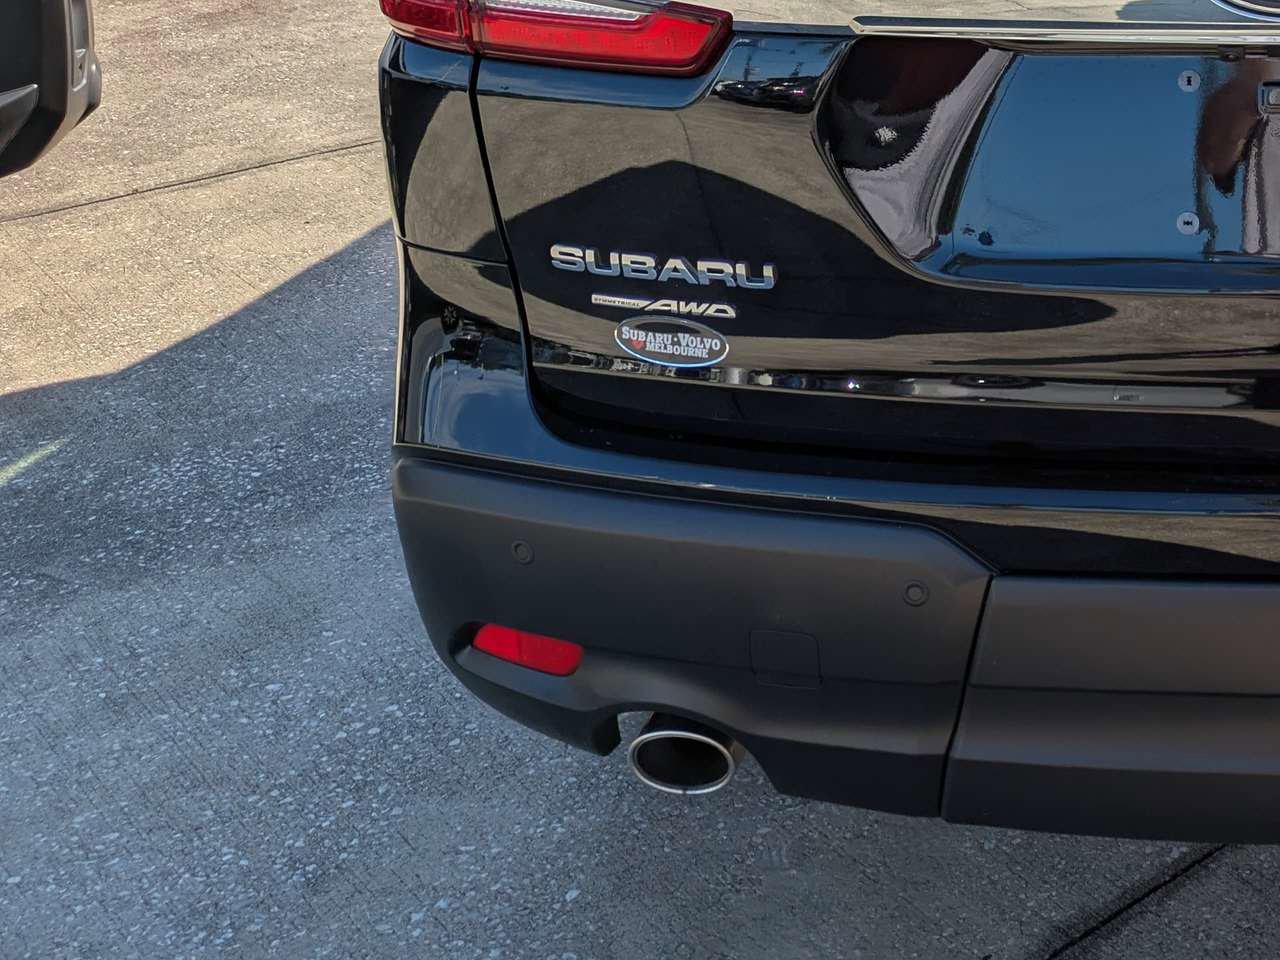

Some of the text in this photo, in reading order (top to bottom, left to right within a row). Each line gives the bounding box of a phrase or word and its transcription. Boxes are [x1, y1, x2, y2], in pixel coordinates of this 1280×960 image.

[550, 244, 776, 290] SUBARU
[594, 297, 736, 319] SYMMETRICAL AWD
[621, 326, 721, 351] SUBARU VOLVO
[645, 341, 709, 358] MELBOURNE
